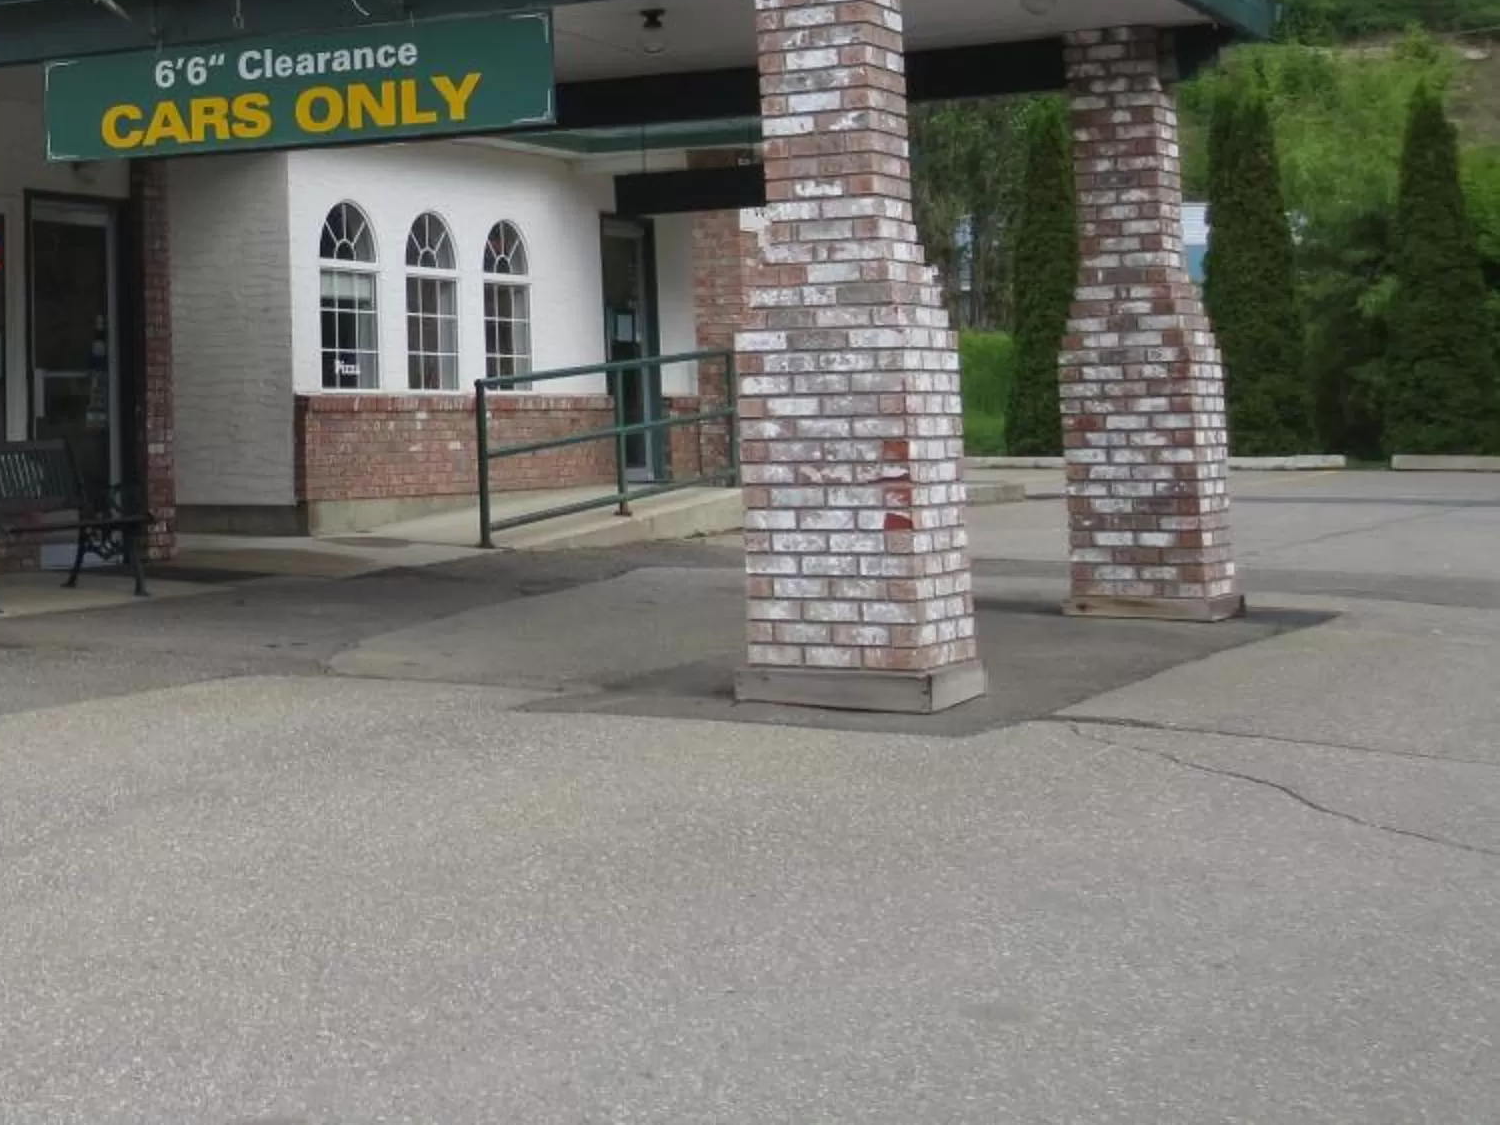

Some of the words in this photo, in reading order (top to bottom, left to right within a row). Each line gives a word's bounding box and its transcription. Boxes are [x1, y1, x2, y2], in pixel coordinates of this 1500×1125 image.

[238, 43, 418, 80] Clearance
[102, 92, 272, 149] CARS
[295, 72, 481, 133] ONLY
